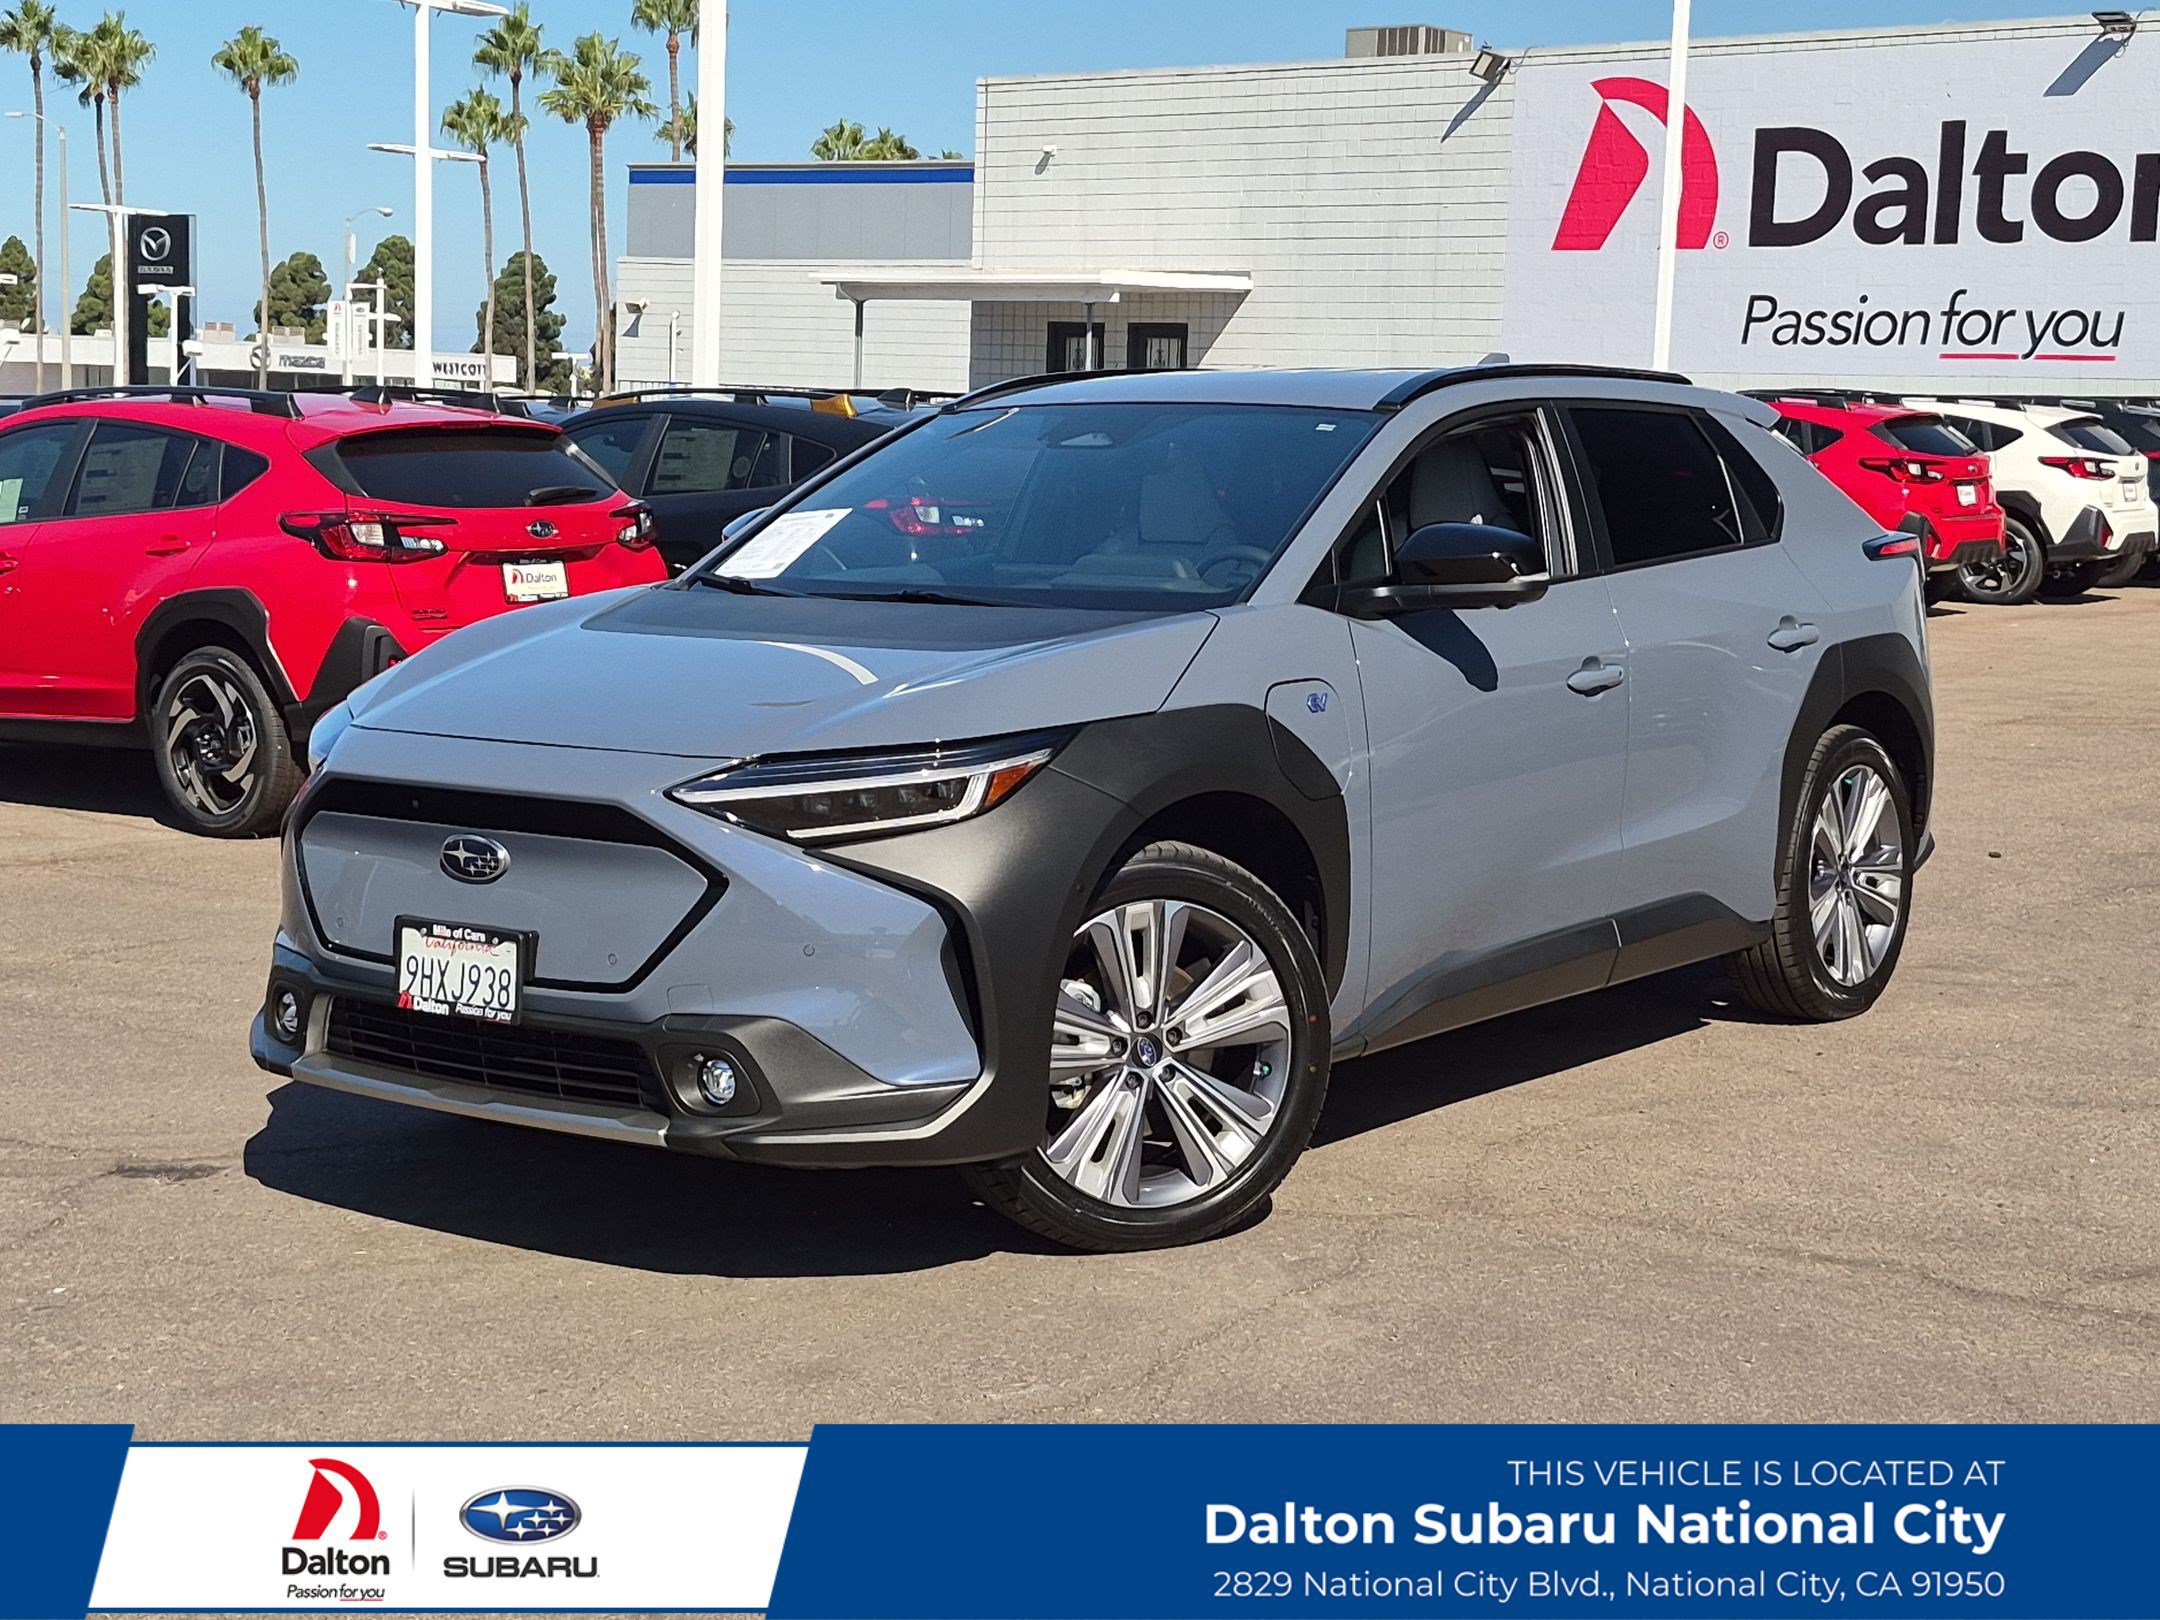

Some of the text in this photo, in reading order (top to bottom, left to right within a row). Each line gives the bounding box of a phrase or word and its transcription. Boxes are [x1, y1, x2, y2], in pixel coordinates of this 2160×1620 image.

[1742, 289, 2125, 360] Passion for you
[525, 572, 557, 583] Dalton
[432, 924, 486, 942] Mile of Cars
[406, 955, 511, 1008] 9HXJ938
[413, 996, 450, 1016] Dalton
[484, 1006, 497, 1018] for
[496, 1009, 512, 1021] you
